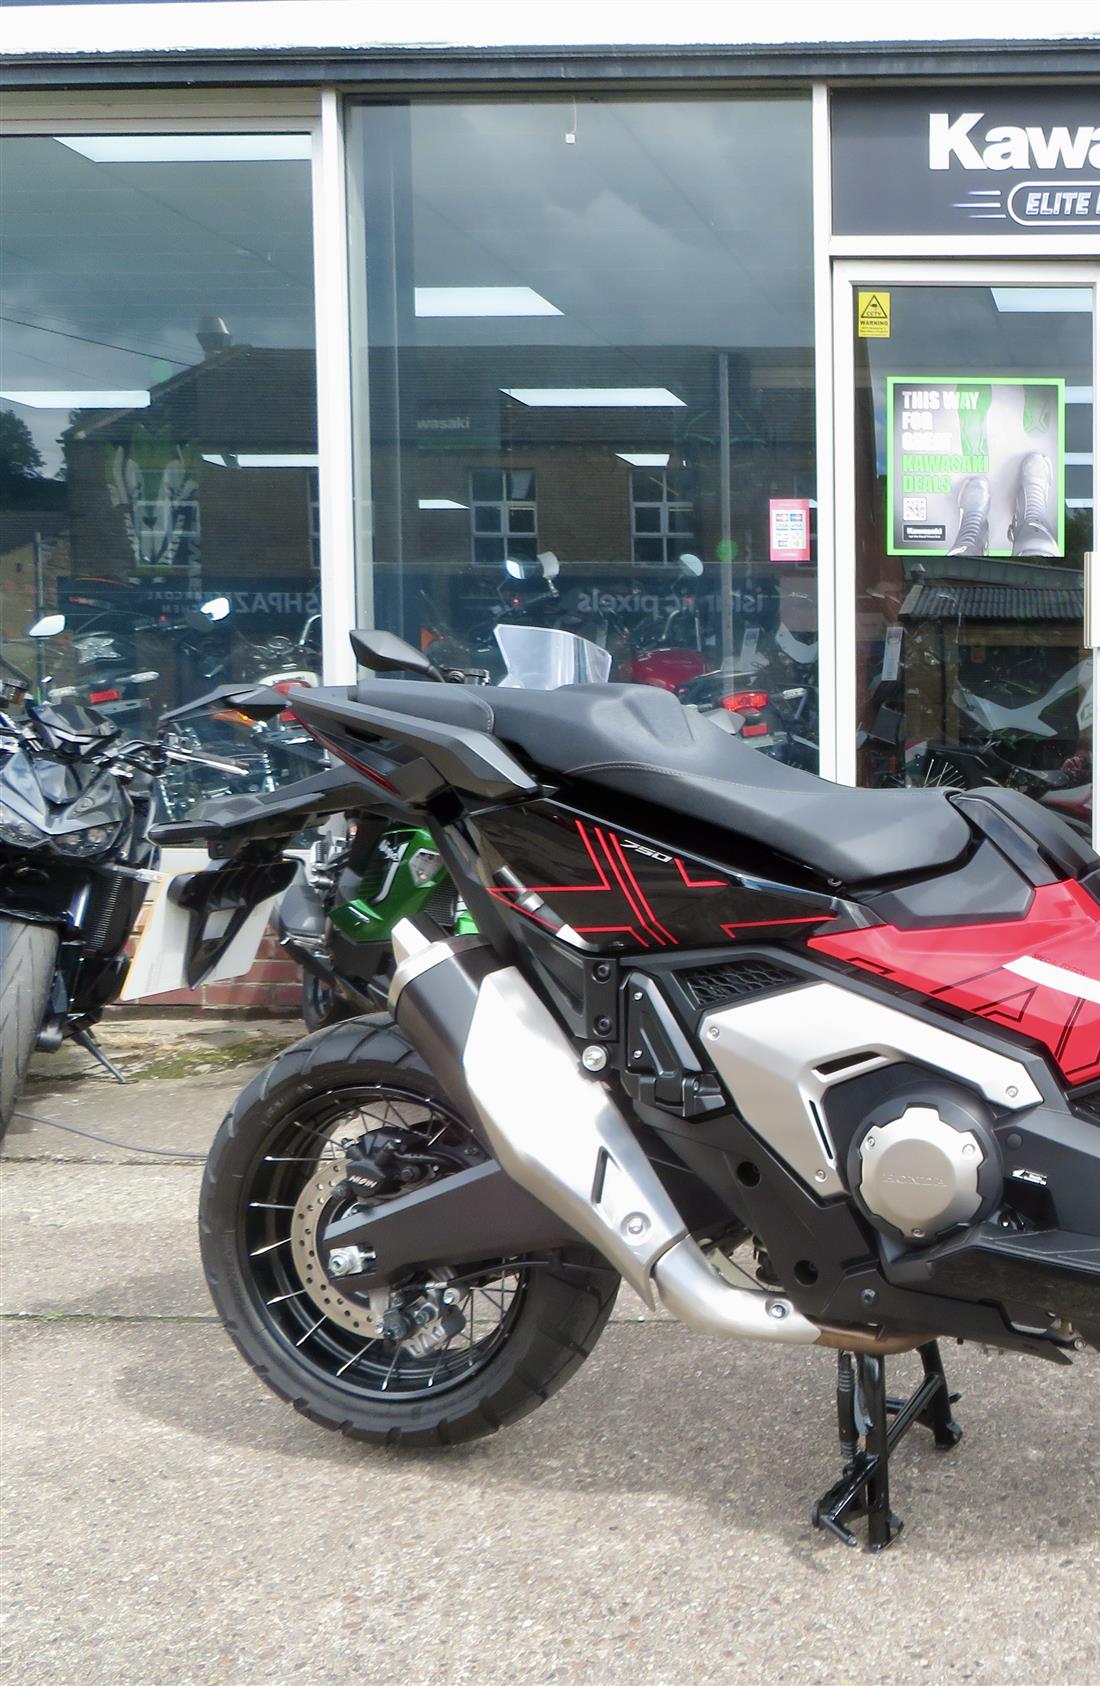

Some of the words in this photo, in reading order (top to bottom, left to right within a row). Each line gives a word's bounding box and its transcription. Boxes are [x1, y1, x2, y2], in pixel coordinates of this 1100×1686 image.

[1025, 191, 1082, 215] ELITE
[902, 391, 940, 410] THIS
[943, 391, 979, 410] WAY
[902, 411, 933, 430] FOR
[903, 454, 989, 473] KAWASAKI
[903, 474, 951, 493] DEALS
[620, 839, 673, 863] 750
